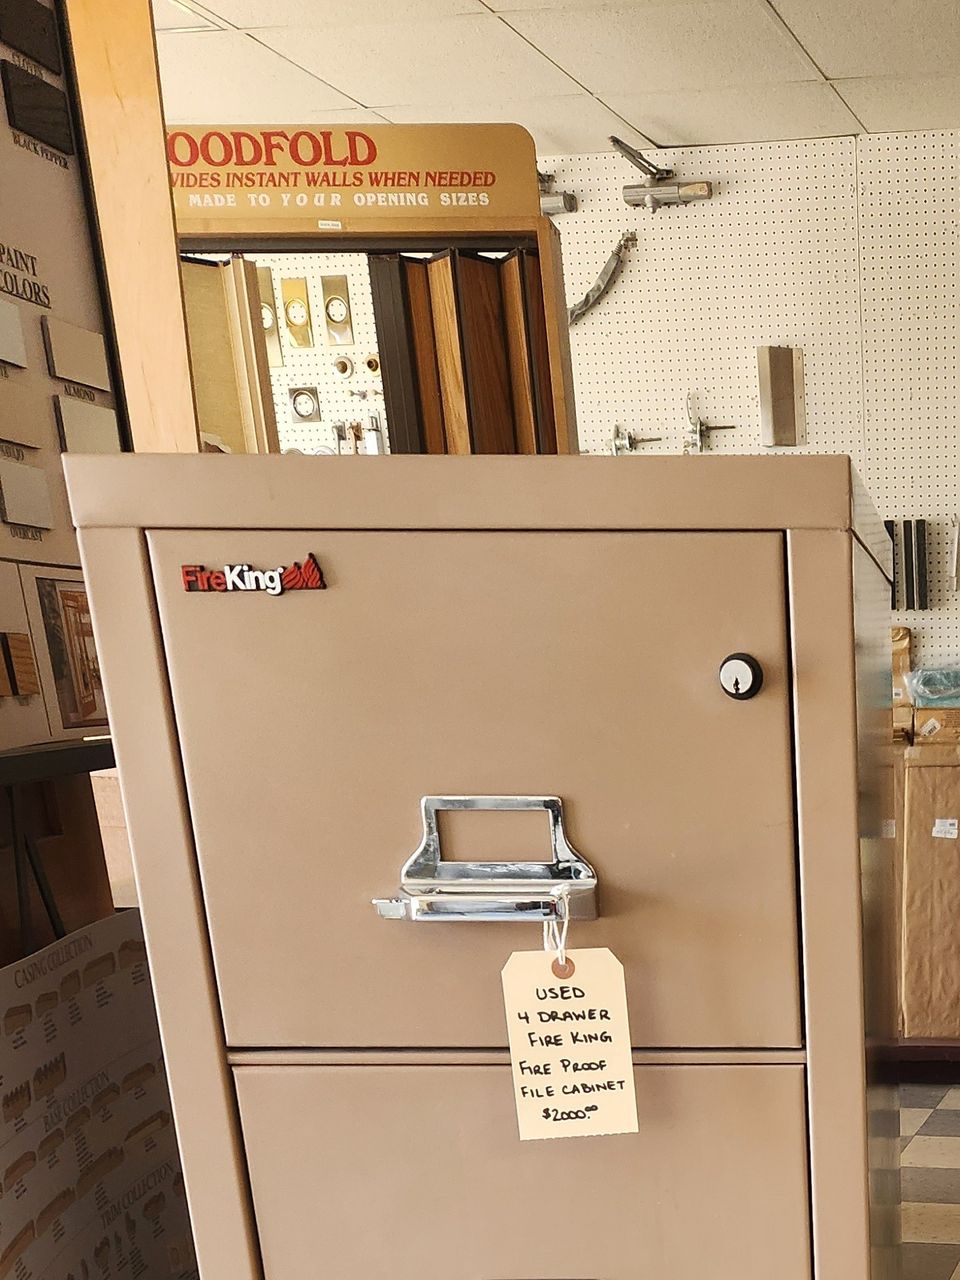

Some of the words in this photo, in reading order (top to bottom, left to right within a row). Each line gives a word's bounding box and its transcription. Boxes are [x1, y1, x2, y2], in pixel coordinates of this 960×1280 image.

[166, 131, 378, 167] OODFOLD
[225, 171, 301, 188] INSTANT
[305, 171, 363, 188] WALLS
[368, 171, 420, 187] WHEN
[424, 171, 497, 188] NEEDED
[188, 193, 237, 207] MADE
[248, 193, 271, 207] TO
[281, 193, 342, 207] YOUR
[353, 193, 429, 207] OPENING
[439, 192, 490, 207] SIZES
[0, 268, 50, 306] OLORS
[181, 564, 285, 596] FireKing
[14, 956, 47, 989] CASING
[47, 934, 93, 971] COLLECTION
[535, 986, 586, 1001] USED
[518, 1011, 530, 1024] 4
[537, 1009, 611, 1023] DRAWER
[527, 1032, 563, 1047] FIRE
[570, 1031, 613, 1045] KING
[518, 1060, 552, 1076] FIRE
[559, 1058, 607, 1073] PROOF
[520, 1086, 555, 1098] FILE
[561, 1080, 626, 1095] CABINET
[122, 1160, 174, 1210] COLLECTION
